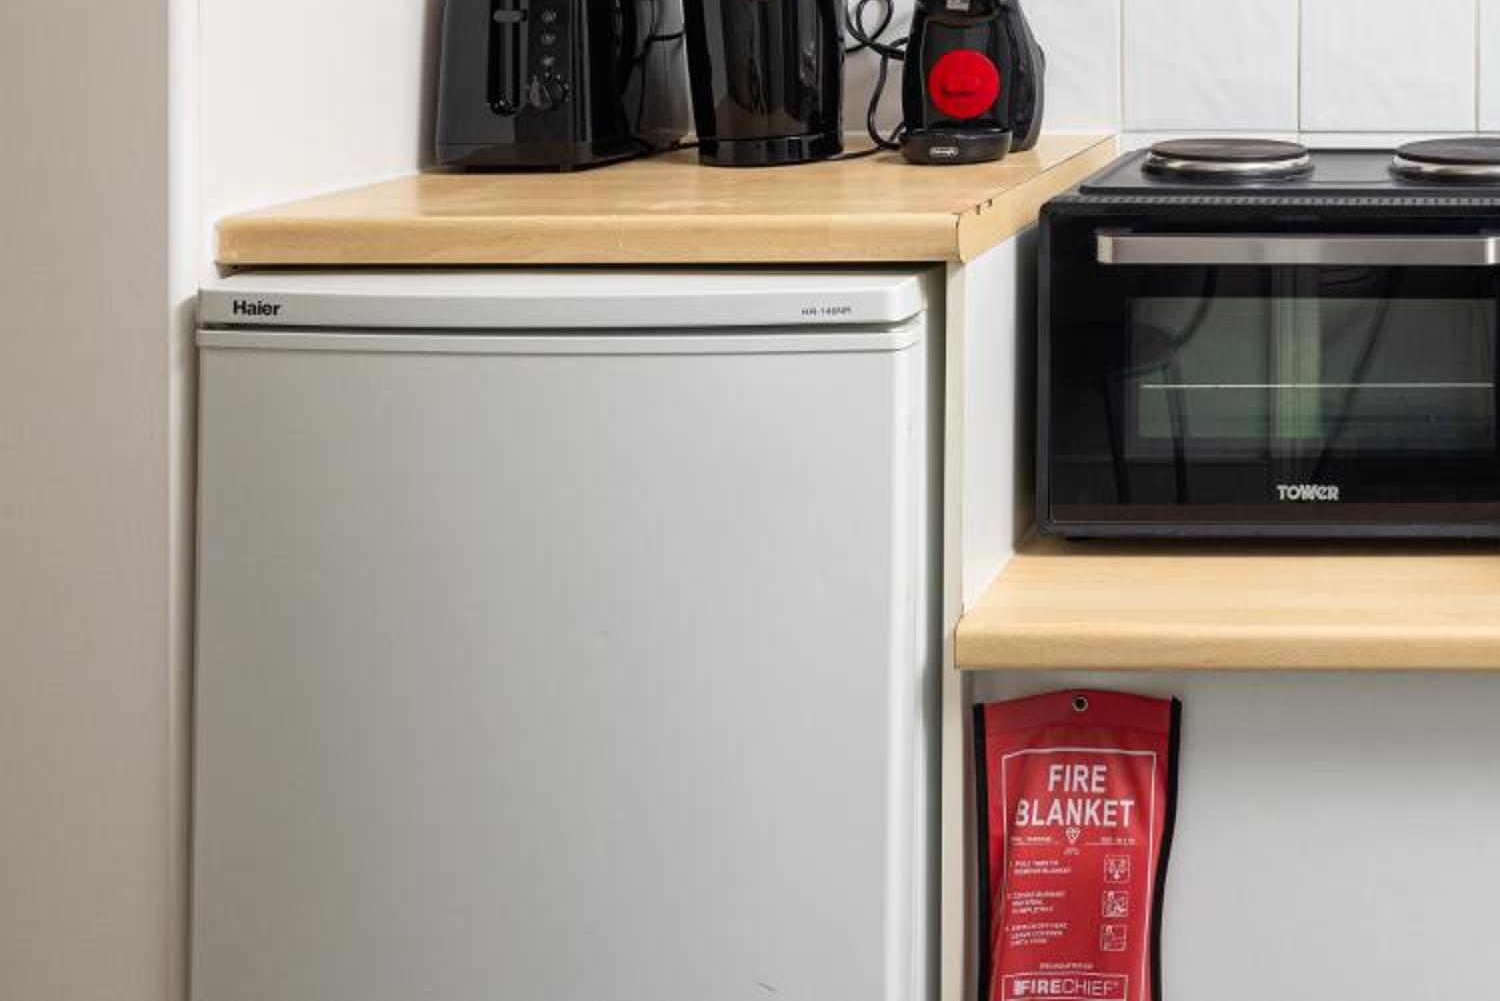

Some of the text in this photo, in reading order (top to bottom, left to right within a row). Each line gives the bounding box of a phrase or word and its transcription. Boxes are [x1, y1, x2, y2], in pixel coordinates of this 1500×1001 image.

[233, 299, 281, 316] Haier
[1276, 484, 1339, 500] TOWER
[1048, 764, 1107, 793] FIRE
[1015, 799, 1135, 827] BLANKET
[1013, 978, 1114, 996] FIRECHIEF
